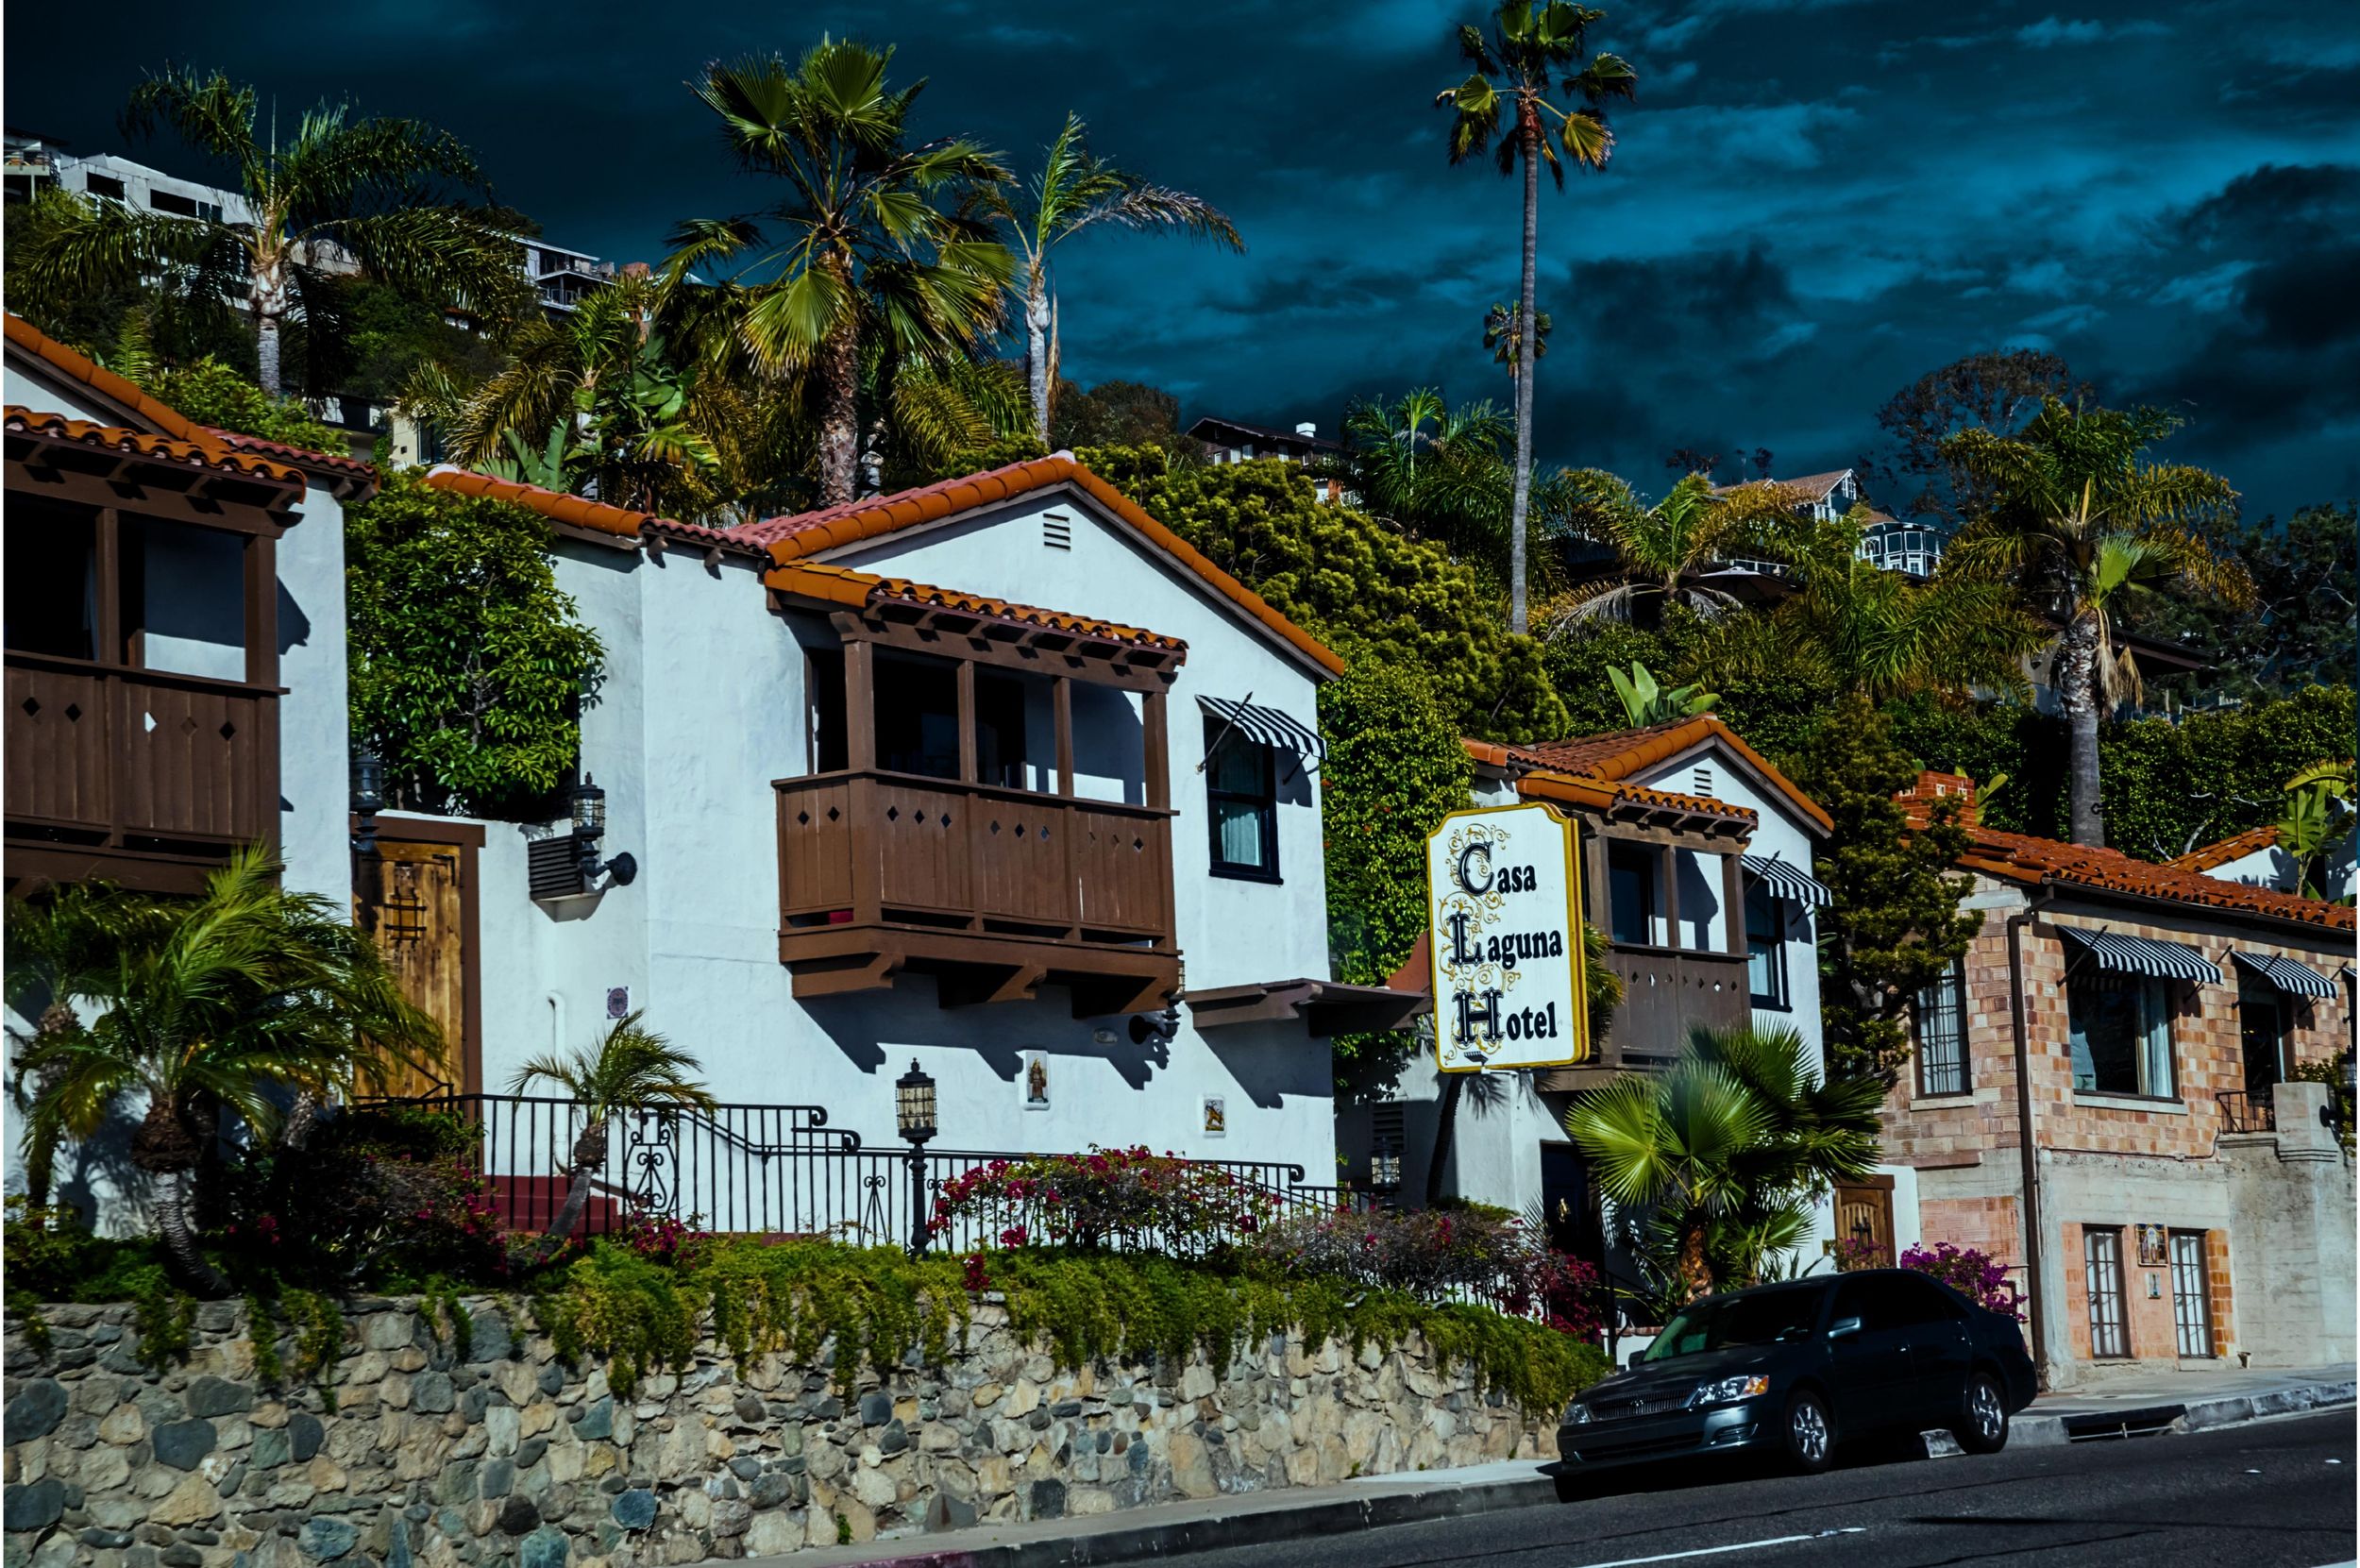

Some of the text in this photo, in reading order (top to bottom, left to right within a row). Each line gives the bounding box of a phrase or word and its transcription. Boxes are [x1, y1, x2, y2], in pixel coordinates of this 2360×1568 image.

[1458, 841, 1537, 895] Casa
[1448, 912, 1563, 970] Laguna
[1452, 987, 1558, 1046] Hotel
